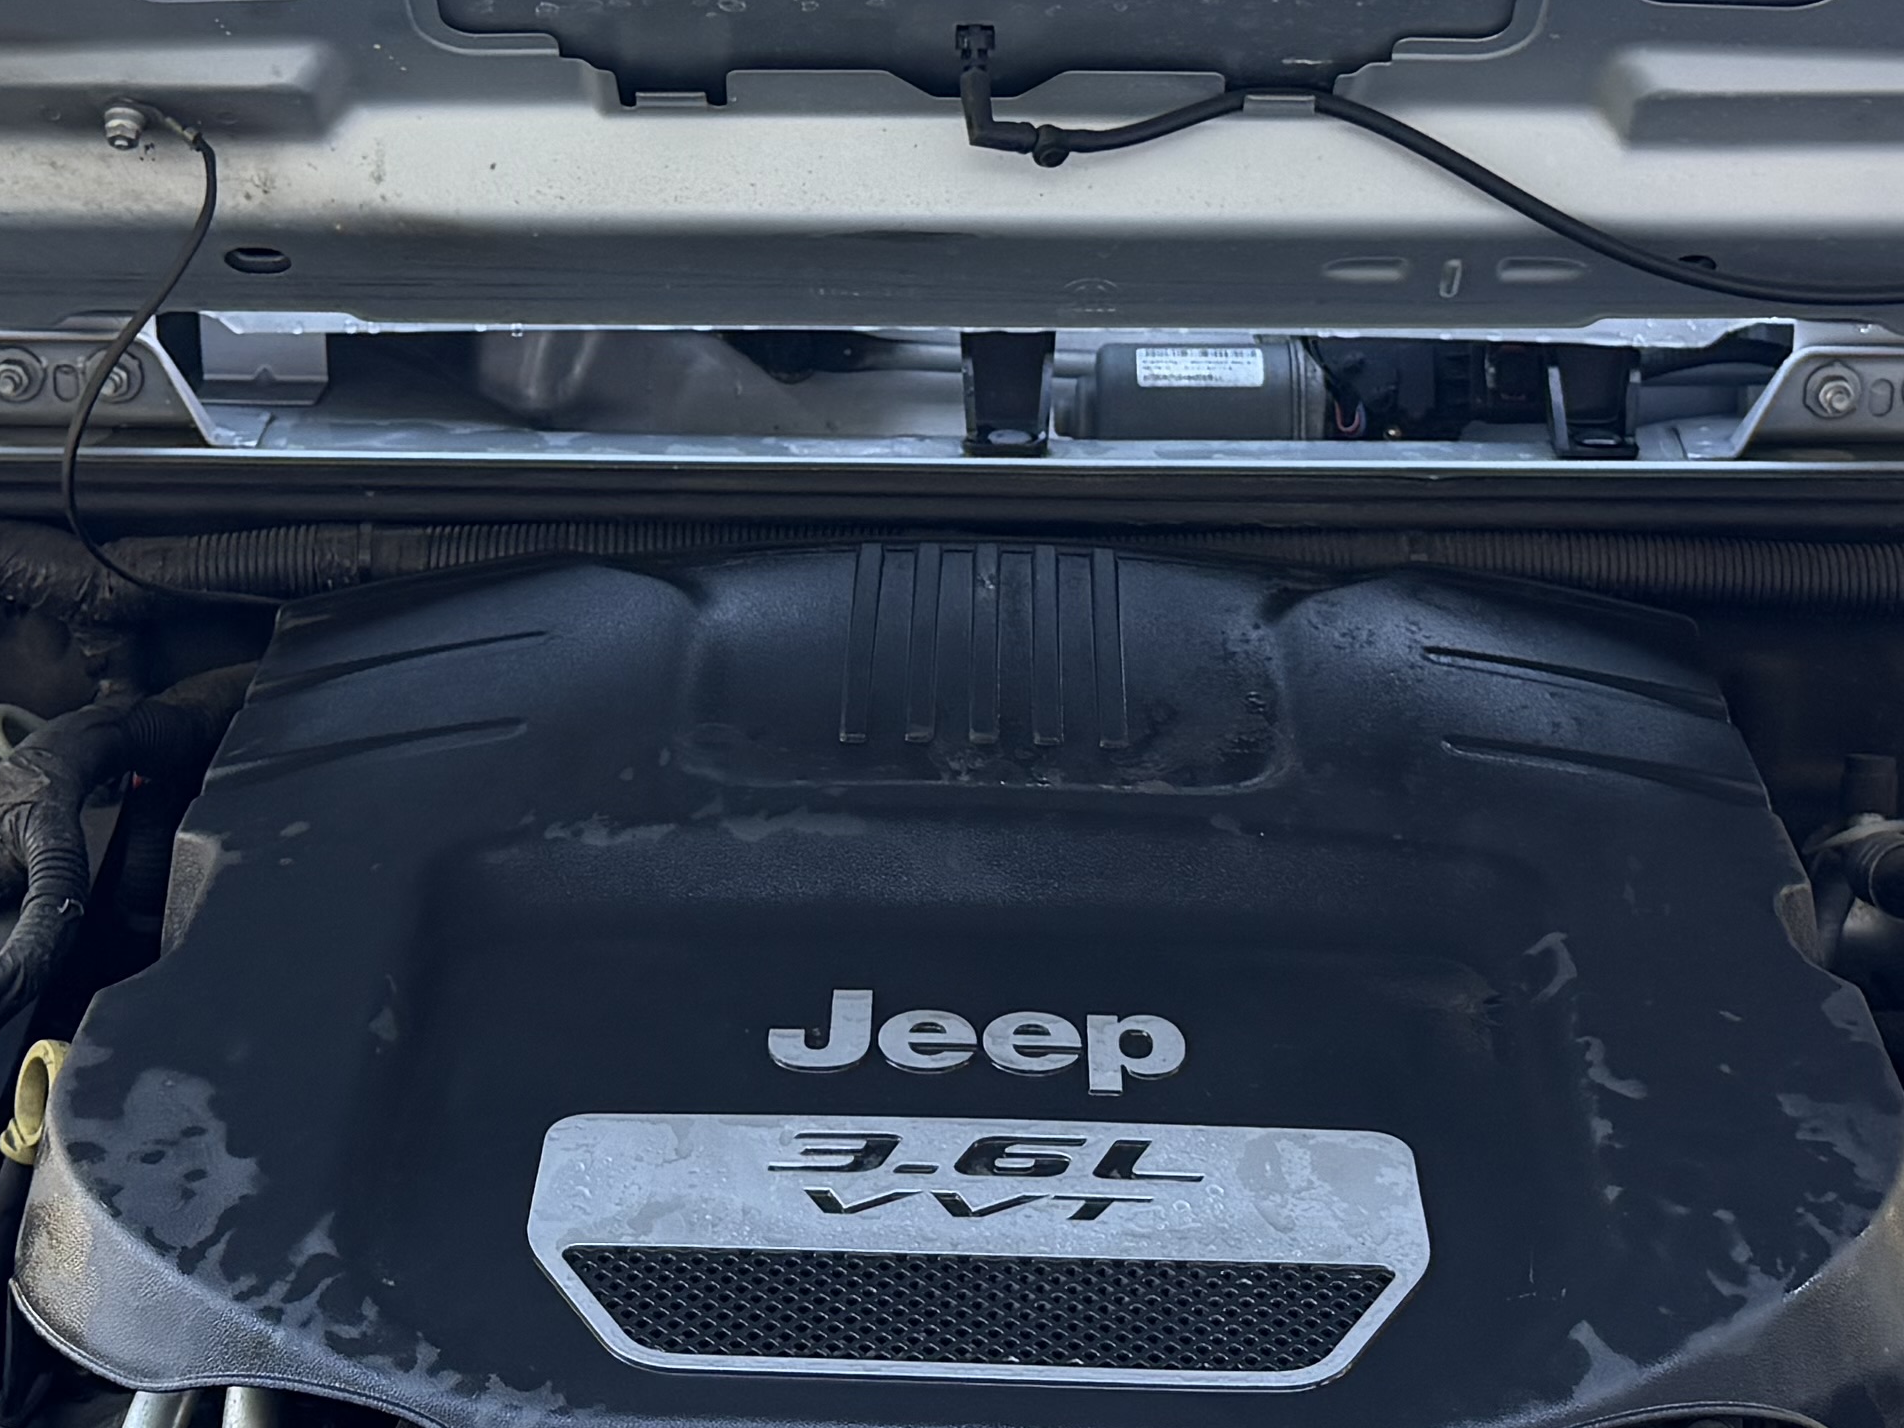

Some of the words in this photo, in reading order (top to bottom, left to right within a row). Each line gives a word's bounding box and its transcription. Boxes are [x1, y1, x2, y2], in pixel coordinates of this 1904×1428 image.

[768, 988, 1186, 1096] Jeep
[768, 1130, 1204, 1183] 3.6L
[802, 1188, 1154, 1222] VVT
